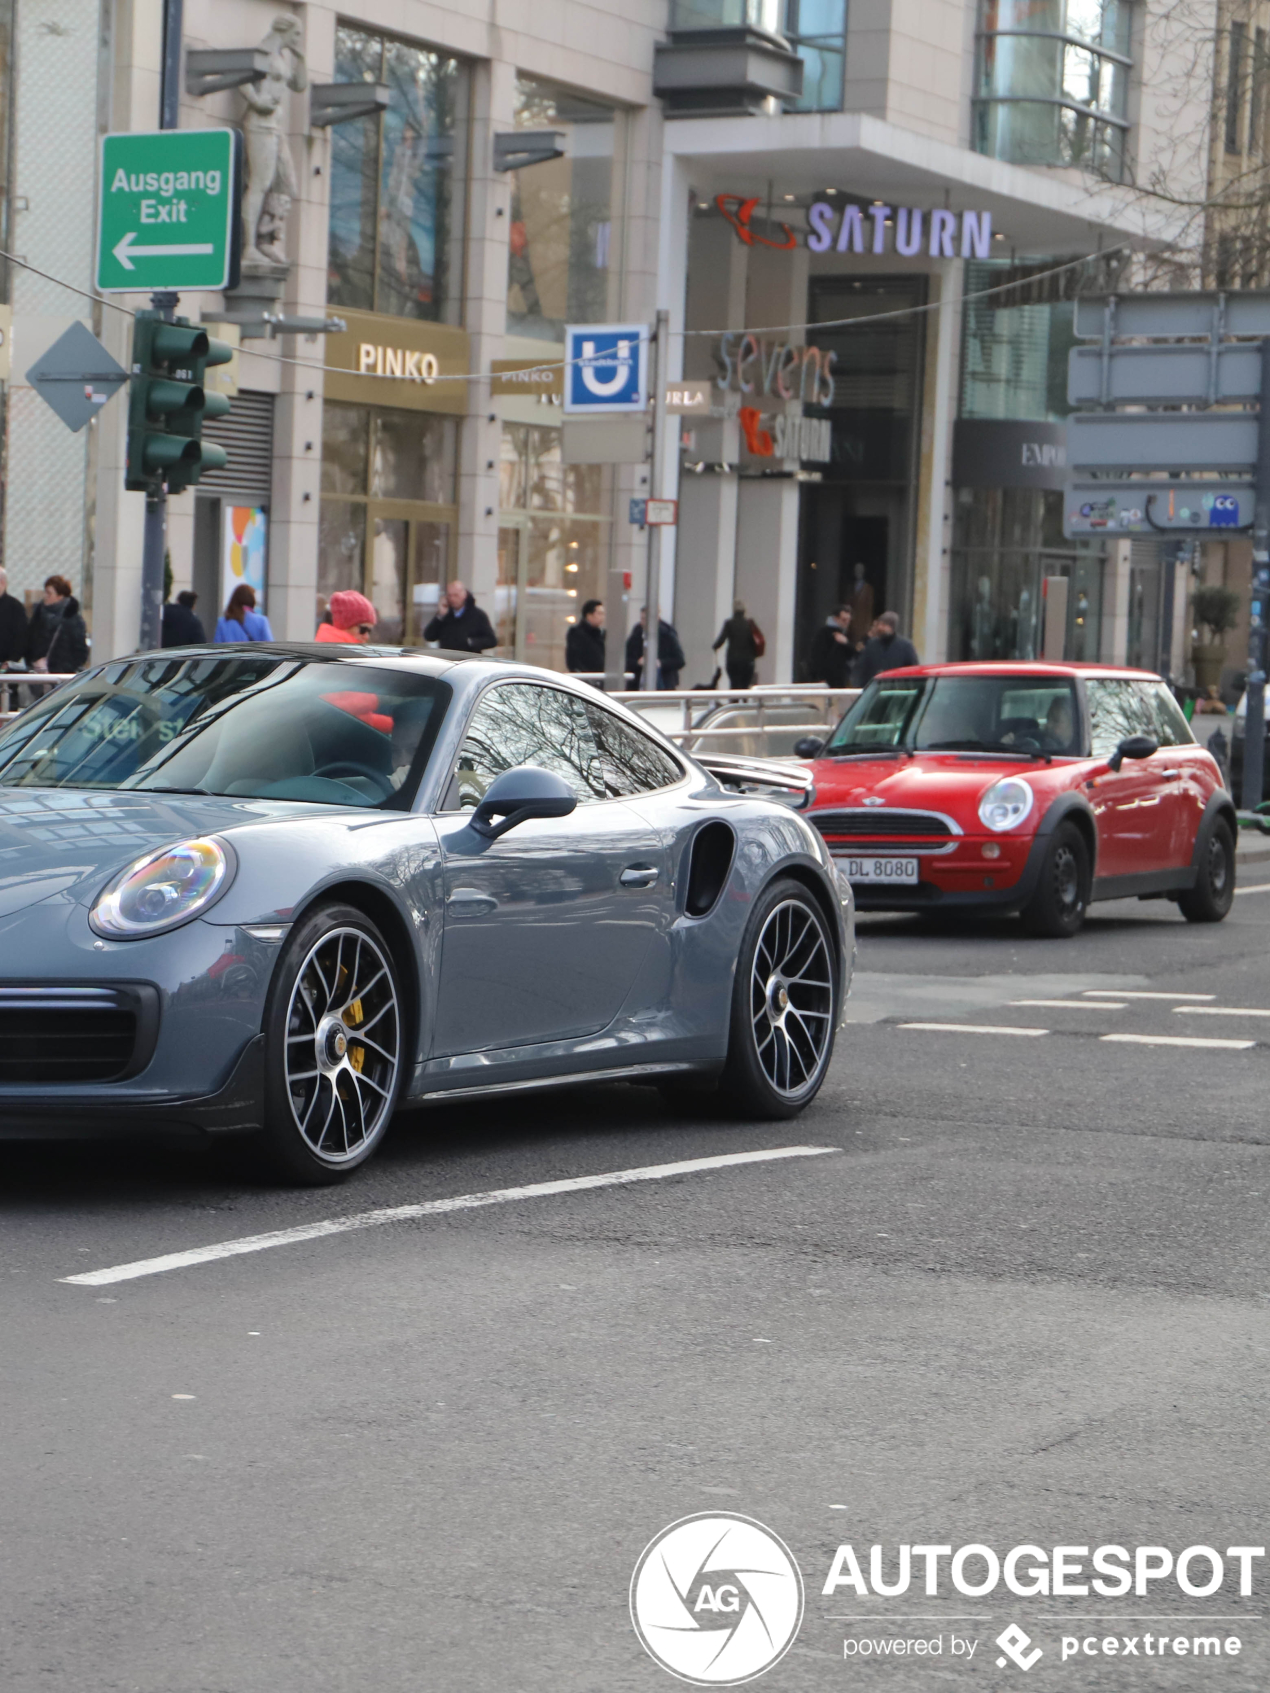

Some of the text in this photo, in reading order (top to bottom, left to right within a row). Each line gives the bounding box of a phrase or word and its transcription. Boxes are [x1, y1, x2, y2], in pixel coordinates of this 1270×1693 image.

[111, 168, 221, 196] Ausgang
[140, 199, 188, 223] Exit
[808, 202, 991, 259] SATURN
[359, 343, 438, 385] PINKO
[501, 371, 554, 383] PINKO
[717, 333, 838, 408] sevens
[849, 861, 915, 877] DL 8080
